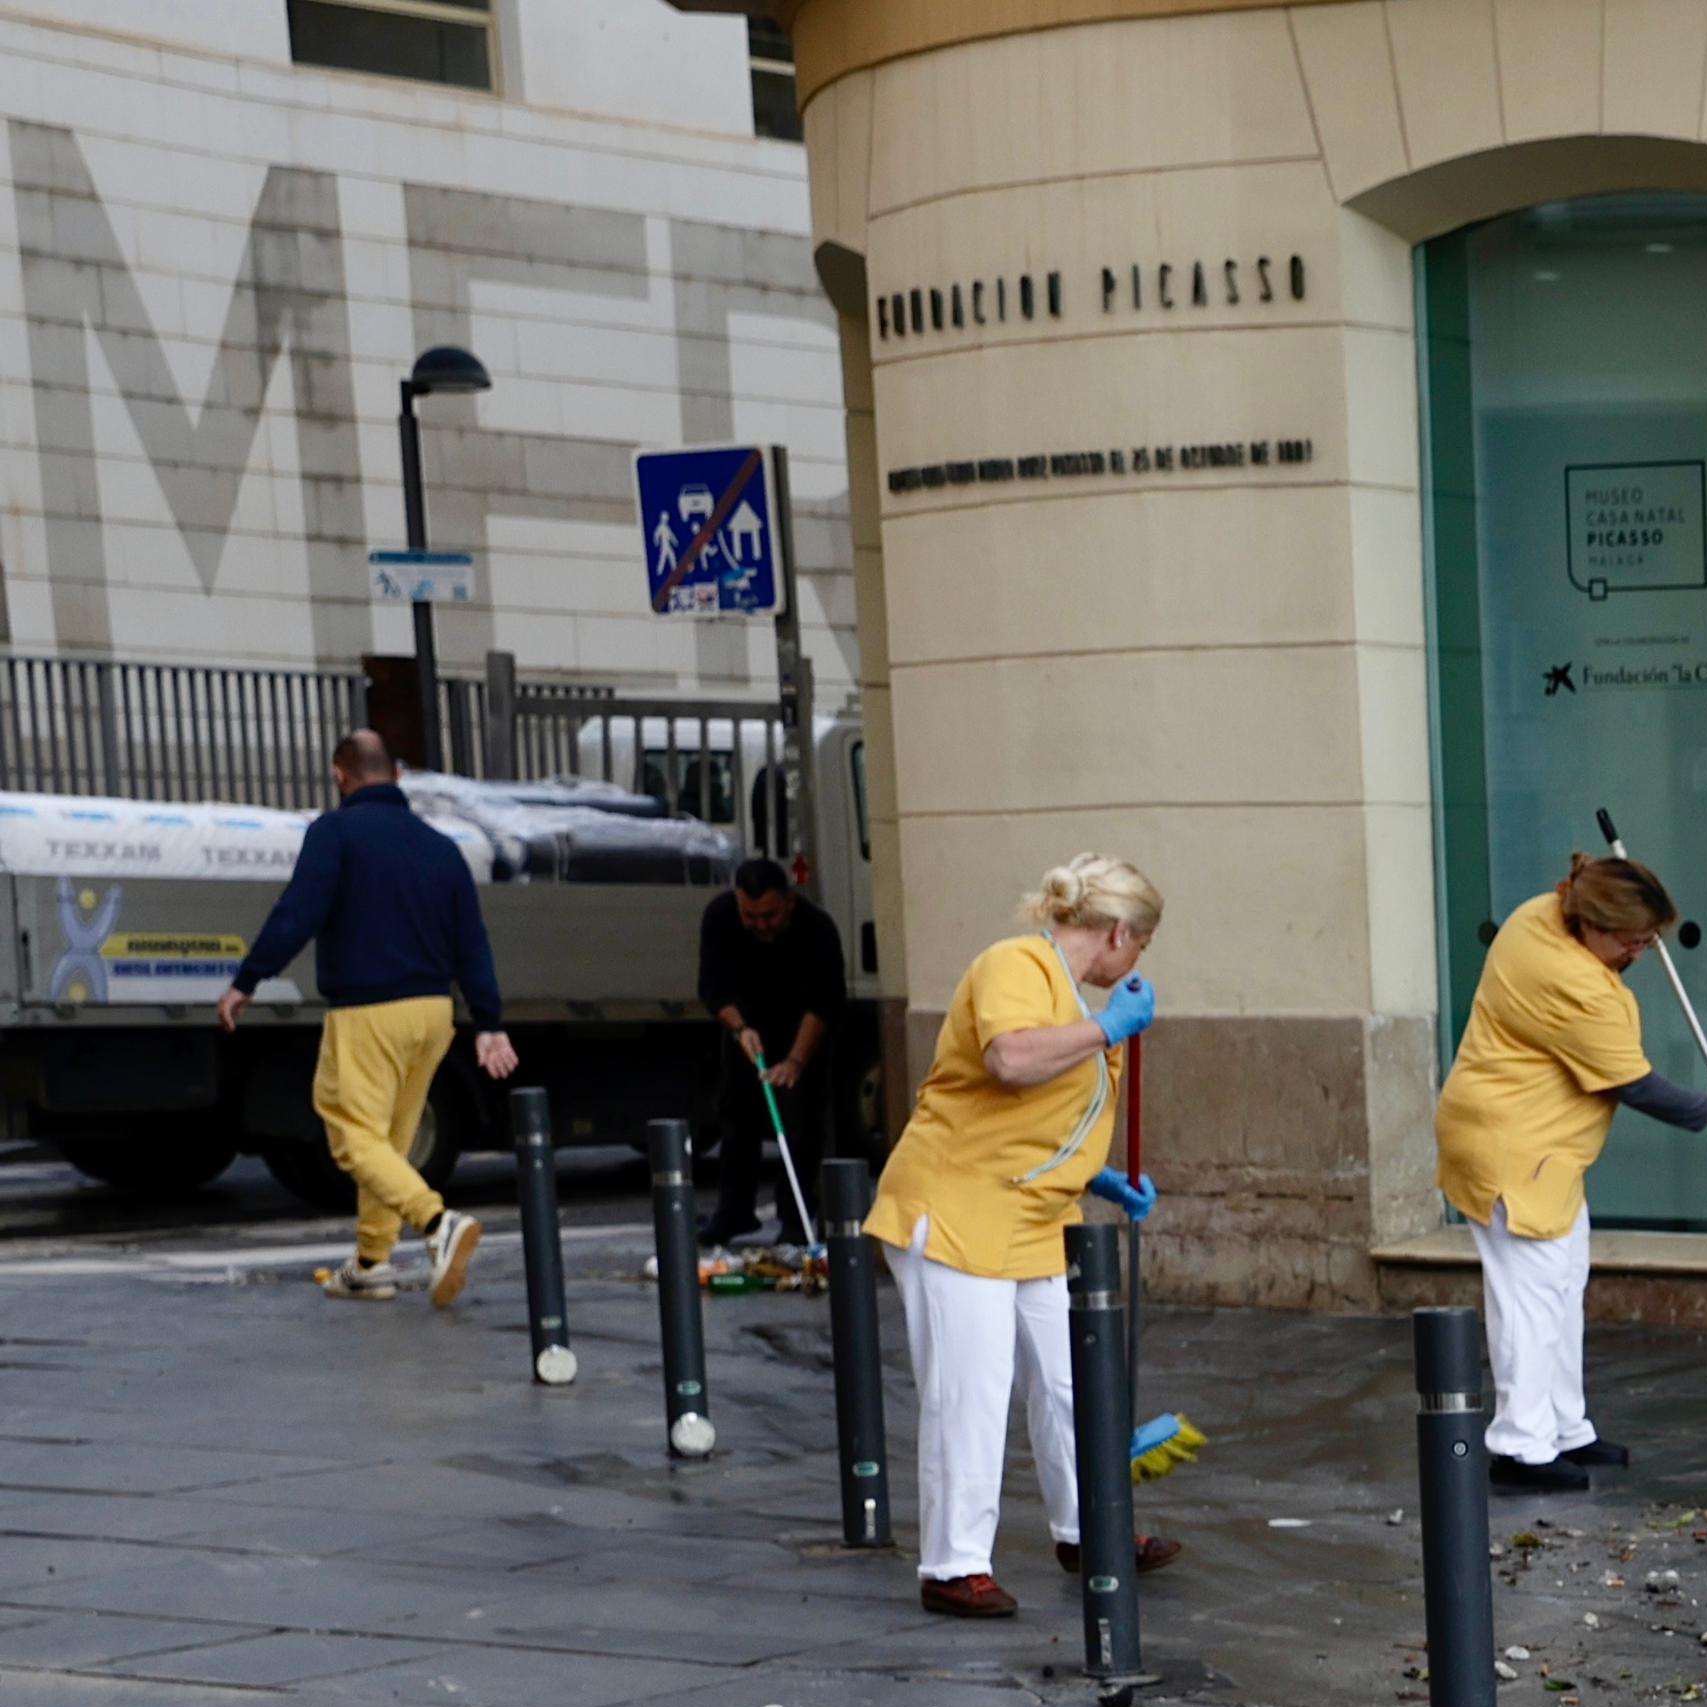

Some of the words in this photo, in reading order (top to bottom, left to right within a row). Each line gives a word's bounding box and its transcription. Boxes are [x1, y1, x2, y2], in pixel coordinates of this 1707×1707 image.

[1101, 253, 1305, 314] PICASSO
[1585, 487, 1643, 505] MUSEO
[1585, 509, 1628, 527] CASA
[1634, 507, 1685, 525] NATAL
[1587, 529, 1664, 547] PICASSO
[1583, 665, 1668, 686] Fundación
